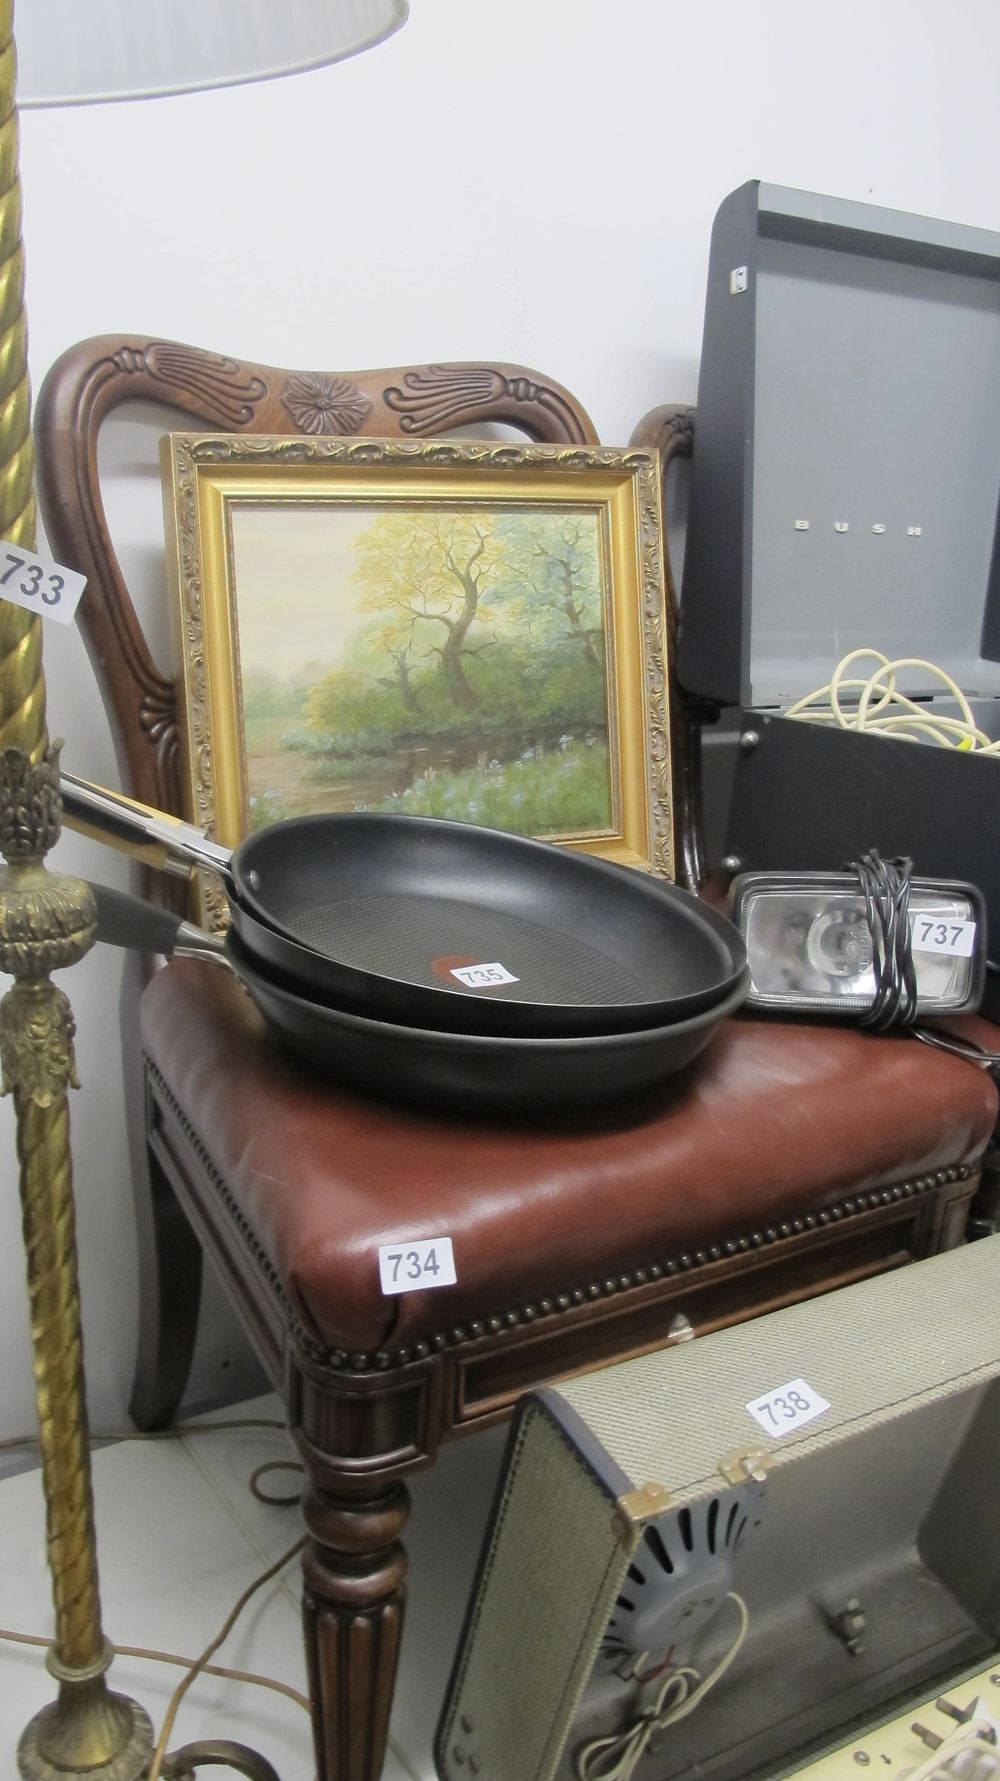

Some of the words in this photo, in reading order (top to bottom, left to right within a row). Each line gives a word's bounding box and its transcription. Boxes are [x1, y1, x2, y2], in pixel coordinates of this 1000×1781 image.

[794, 520, 921, 536] BUSH
[0, 553, 65, 605] 733
[921, 922, 963, 946] 737
[460, 969, 504, 983] 735
[388, 1248, 440, 1281] 734
[758, 1391, 810, 1425] 738
